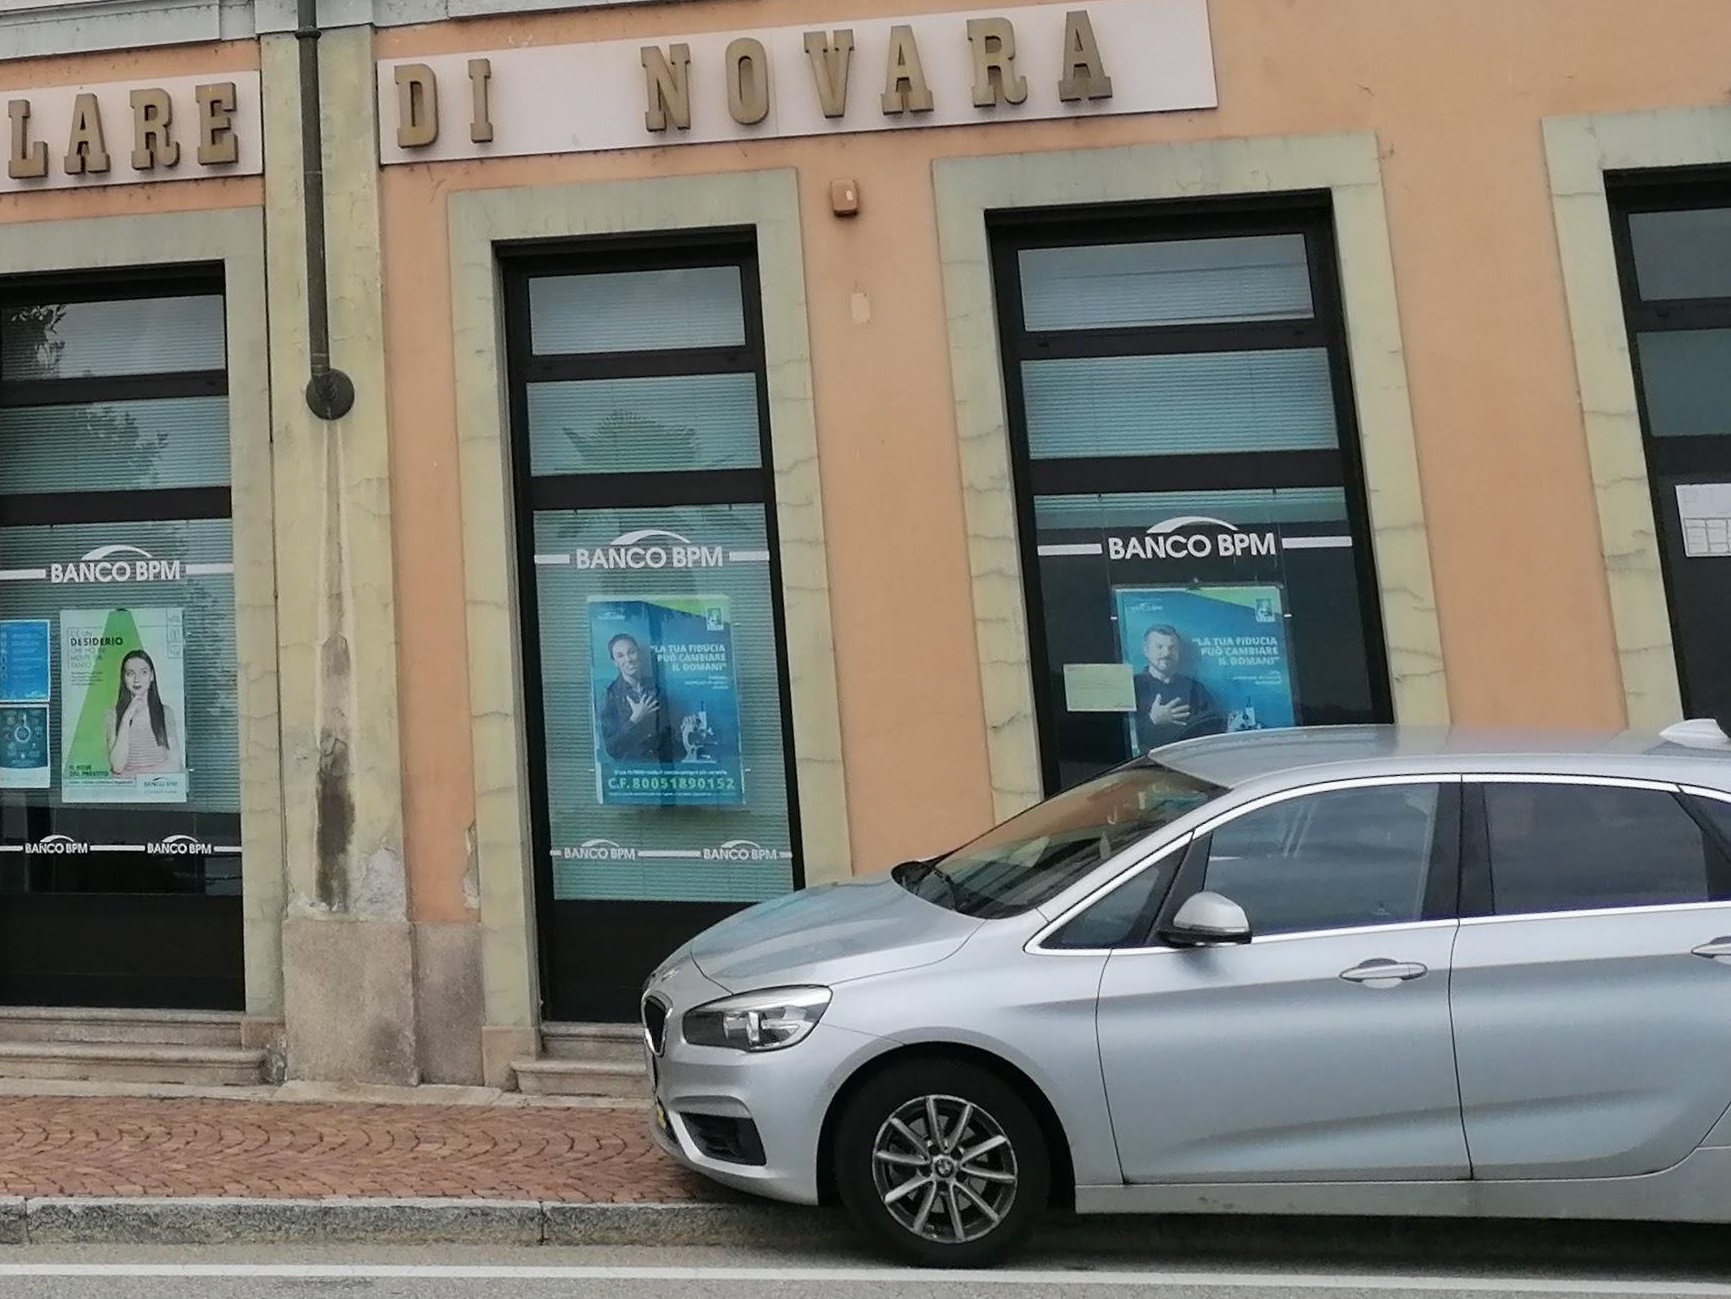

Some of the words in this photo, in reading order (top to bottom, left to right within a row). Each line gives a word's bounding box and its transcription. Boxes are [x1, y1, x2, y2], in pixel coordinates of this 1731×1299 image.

[393, 58, 494, 150] DI
[640, 9, 1114, 134] NOVARA
[576, 546, 668, 570] BANCO
[671, 546, 724, 568] BPM
[1109, 534, 1213, 561] BANCO
[1216, 532, 1277, 558] BPM
[50, 561, 131, 583] BANCO
[135, 560, 181, 582] BPM
[70, 636, 124, 647] DESIDERIO
[25, 843, 65, 854] BANCO
[66, 842, 88, 854] BPM
[147, 843, 188, 855] BANCO
[189, 842, 212, 854] BPM
[564, 848, 608, 860] BANCO
[610, 848, 636, 859] BPM
[703, 849, 749, 860] BANCO
[751, 849, 777, 860] BPM
